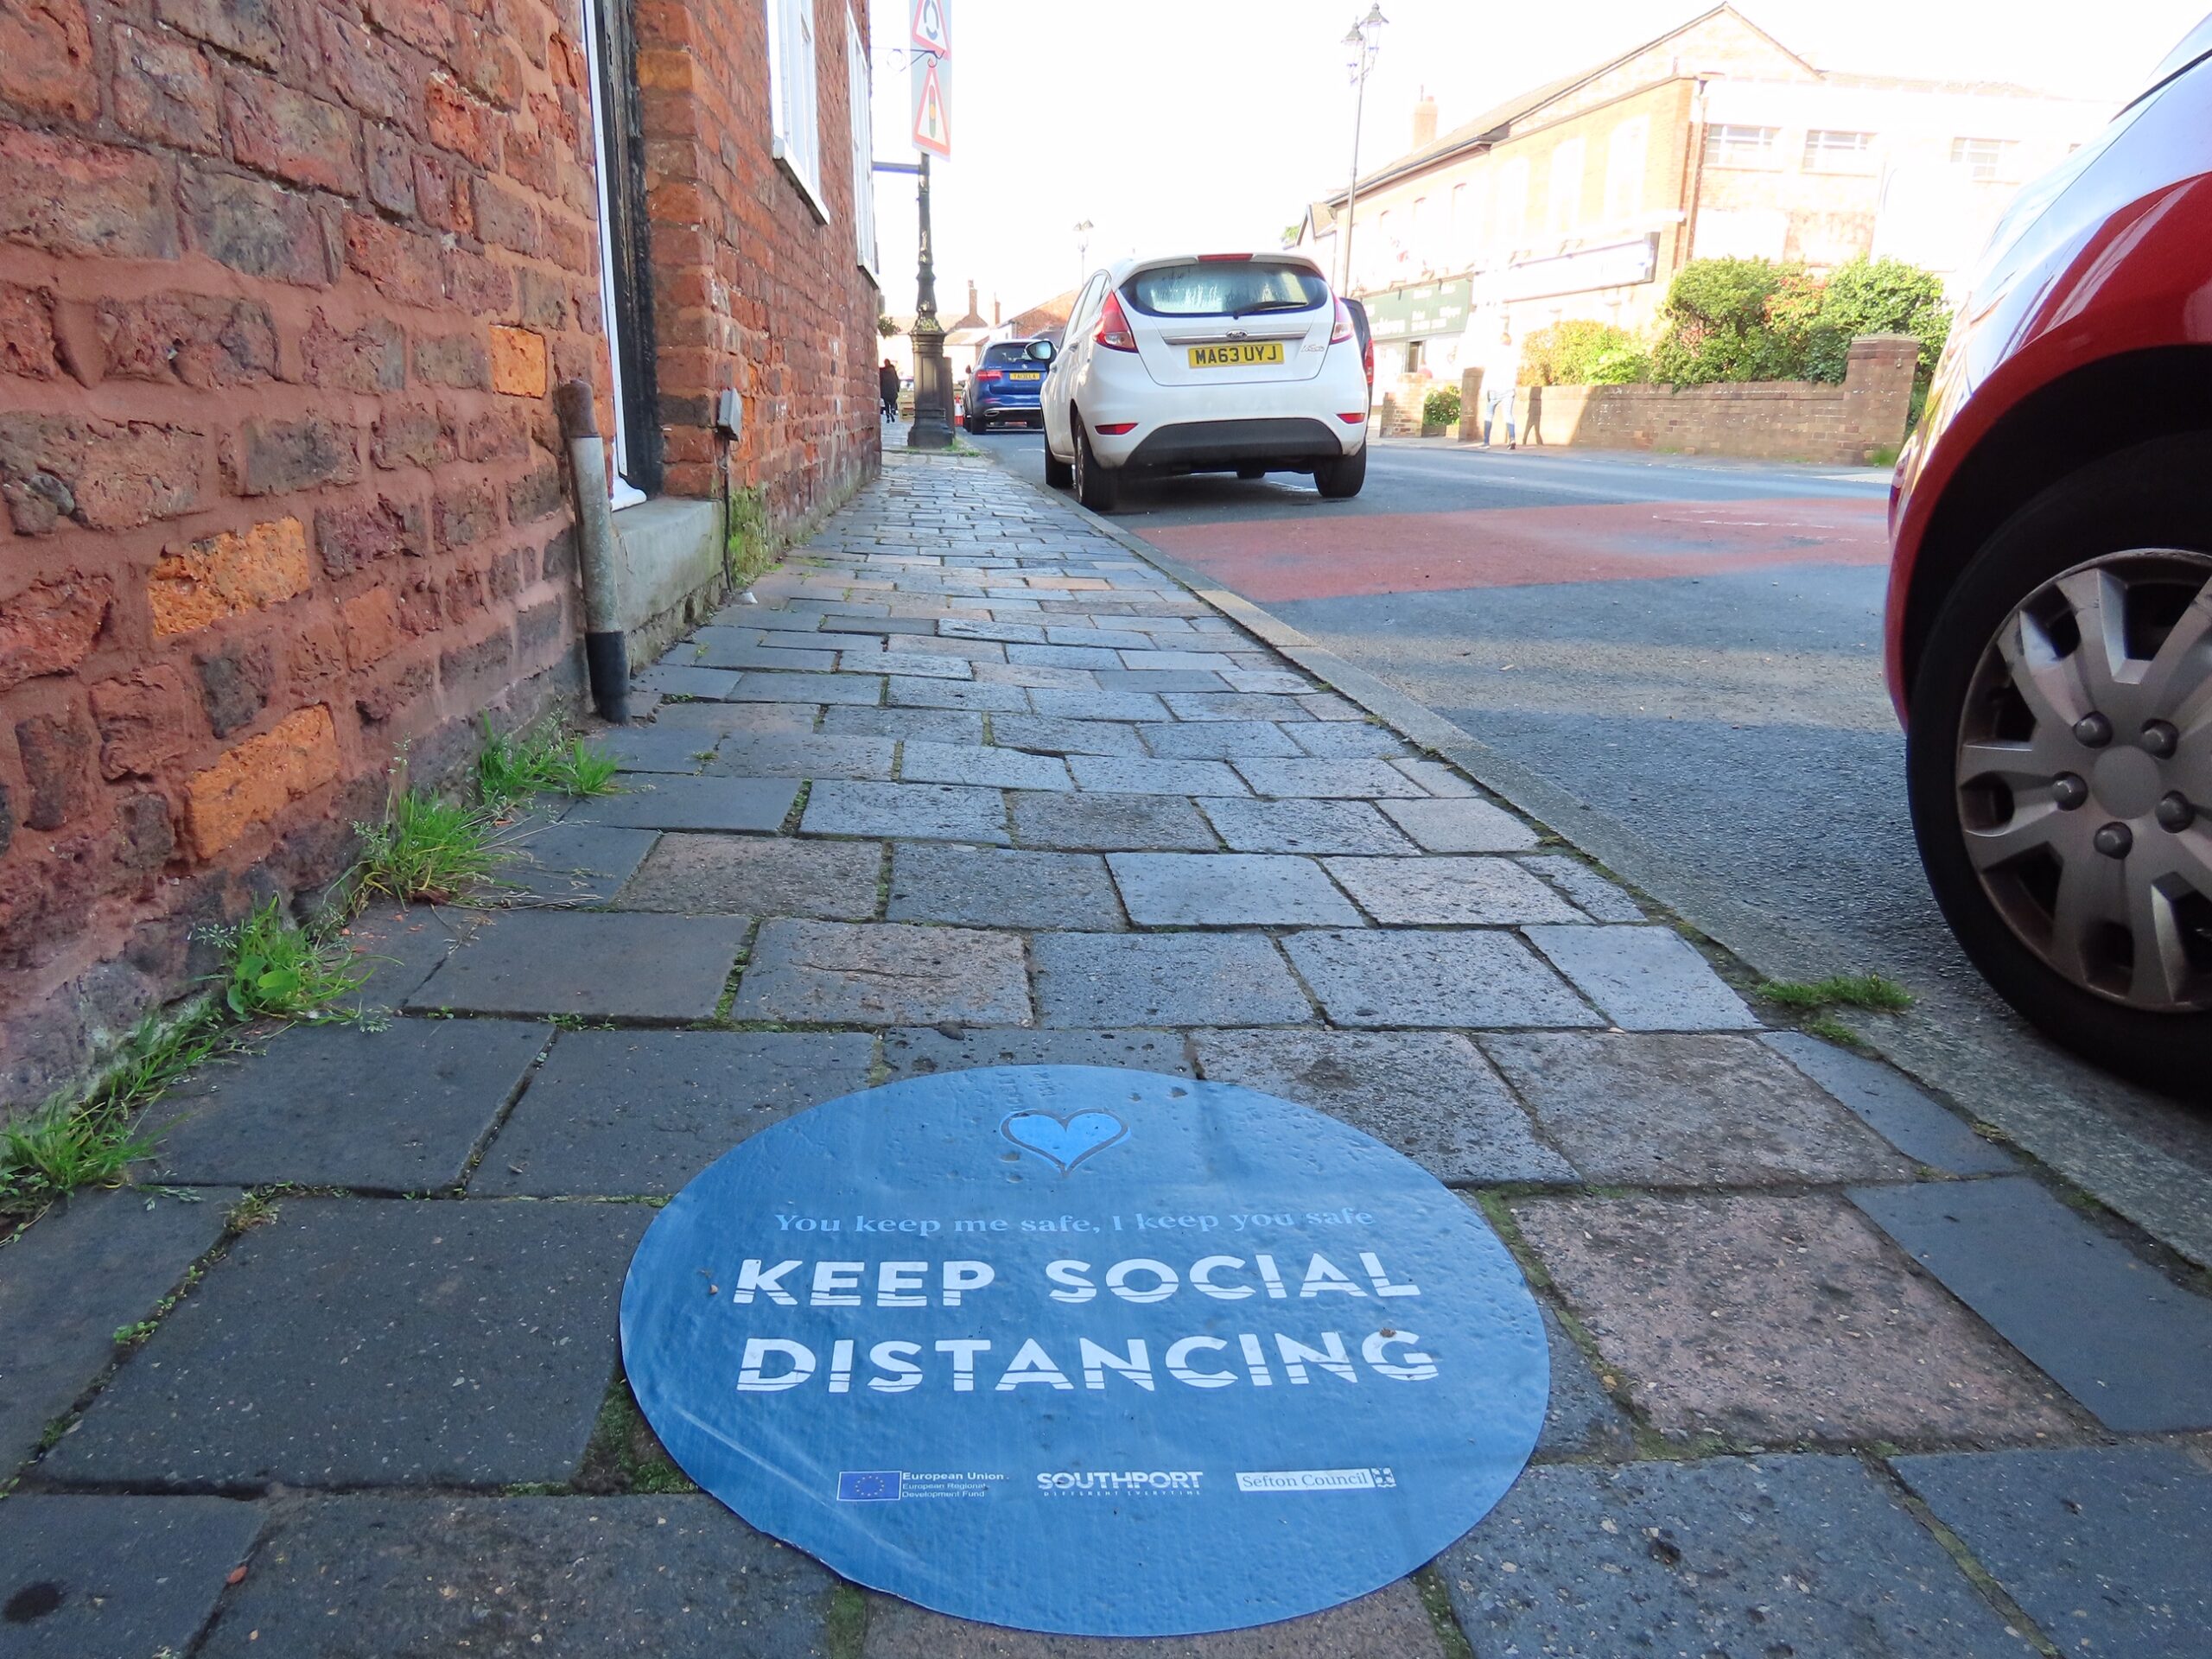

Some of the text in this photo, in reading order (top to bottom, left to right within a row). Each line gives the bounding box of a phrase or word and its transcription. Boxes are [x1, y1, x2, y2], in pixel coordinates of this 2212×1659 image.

[1195, 346, 1277, 365] MA63 UYJ
[774, 1208, 1375, 1236] You keep me safe, I keep you safe
[733, 1252, 1421, 1306] KEEP SOCIAL
[736, 1330, 1440, 1394] DISTANCING
[902, 1471, 1004, 1482] European Union
[1036, 1471, 1204, 1491] SOUTHPORT
[1242, 1471, 1369, 1488] Sefton Council
[947, 1482, 988, 1491] Regional
